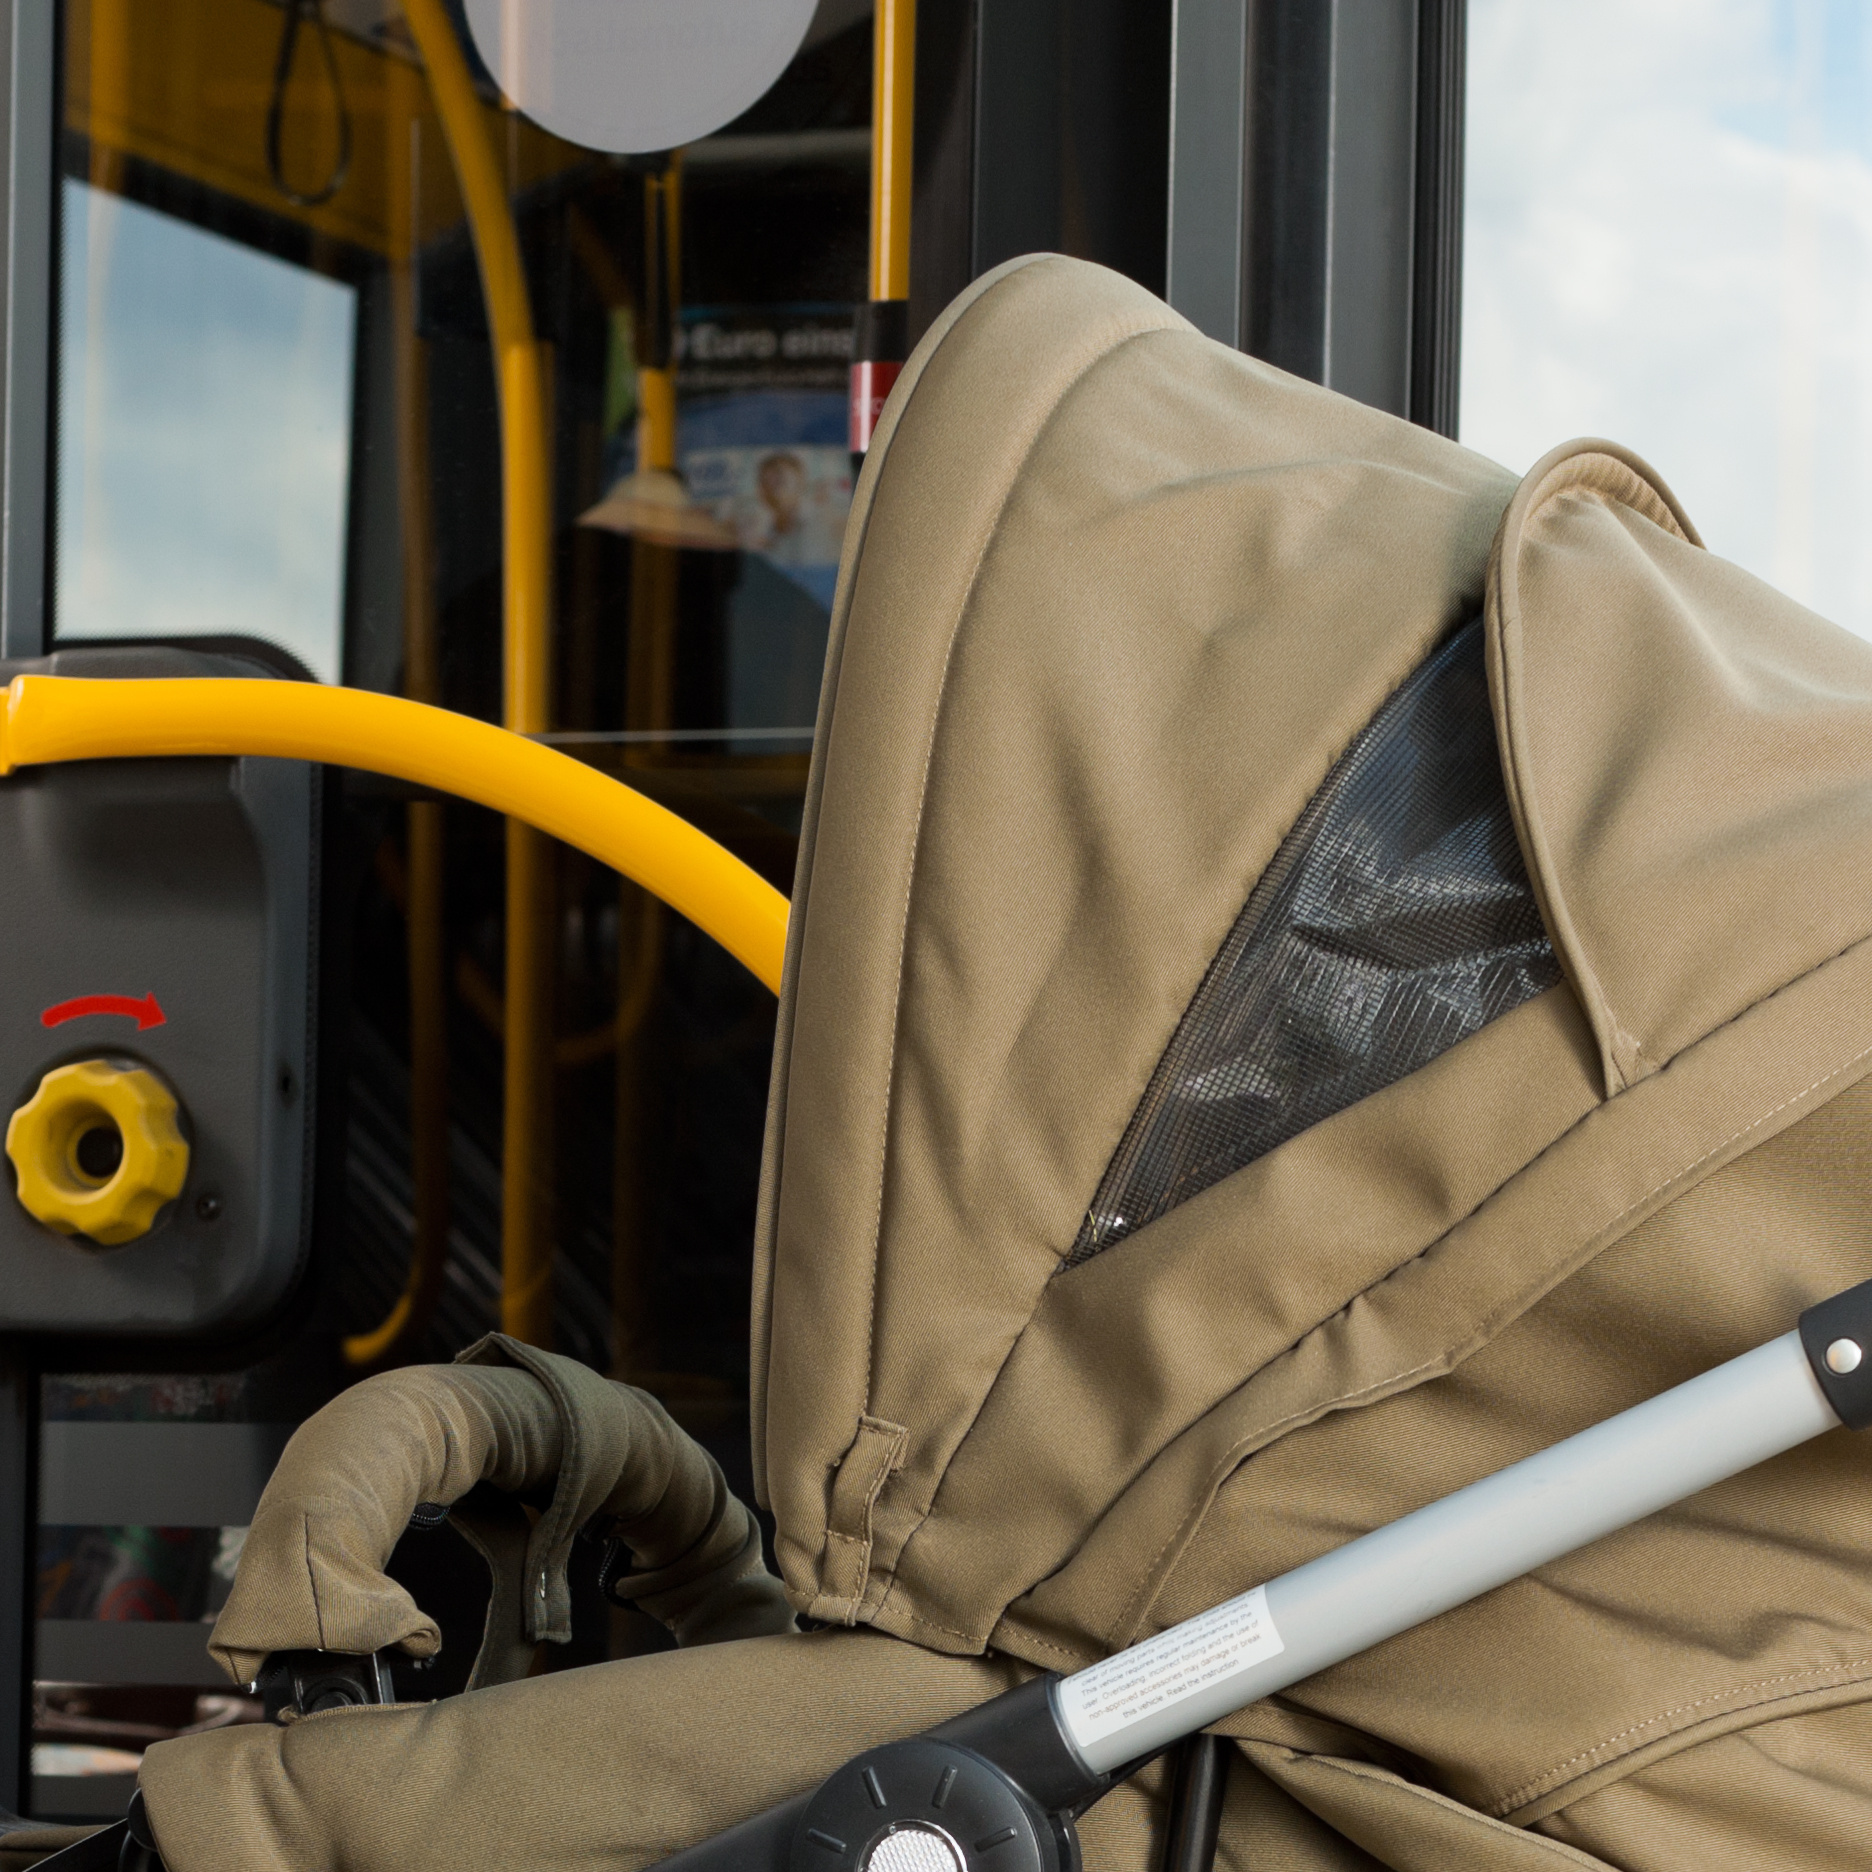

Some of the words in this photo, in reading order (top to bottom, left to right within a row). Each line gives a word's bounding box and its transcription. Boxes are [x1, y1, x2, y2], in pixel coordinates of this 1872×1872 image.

[1081, 1686, 1097, 1696] This
[1099, 1673, 1123, 1687] vehicle
[1125, 1658, 1154, 1675] requires
[1156, 1645, 1180, 1660] regular
[1182, 1623, 1228, 1646] maintenance
[1239, 1611, 1251, 1620] the
[1139, 1671, 1182, 1696] accessories
[1183, 1664, 1199, 1674] may
[1200, 1648, 1229, 1666] damage
[1230, 1643, 1238, 1652] or
[1239, 1634, 1260, 1647] break
[1148, 1657, 1180, 1677] incorrect
[1181, 1646, 1206, 1661] folding
[1207, 1637, 1221, 1649] and
[1221, 1632, 1234, 1641] the
[1236, 1625, 1249, 1635] use
[1250, 1618, 1258, 1628] of
[1122, 1708, 1137, 1718] this
[1166, 1683, 1186, 1696] Read
[1186, 1678, 1199, 1687] the
[1200, 1659, 1238, 1680] instruction
